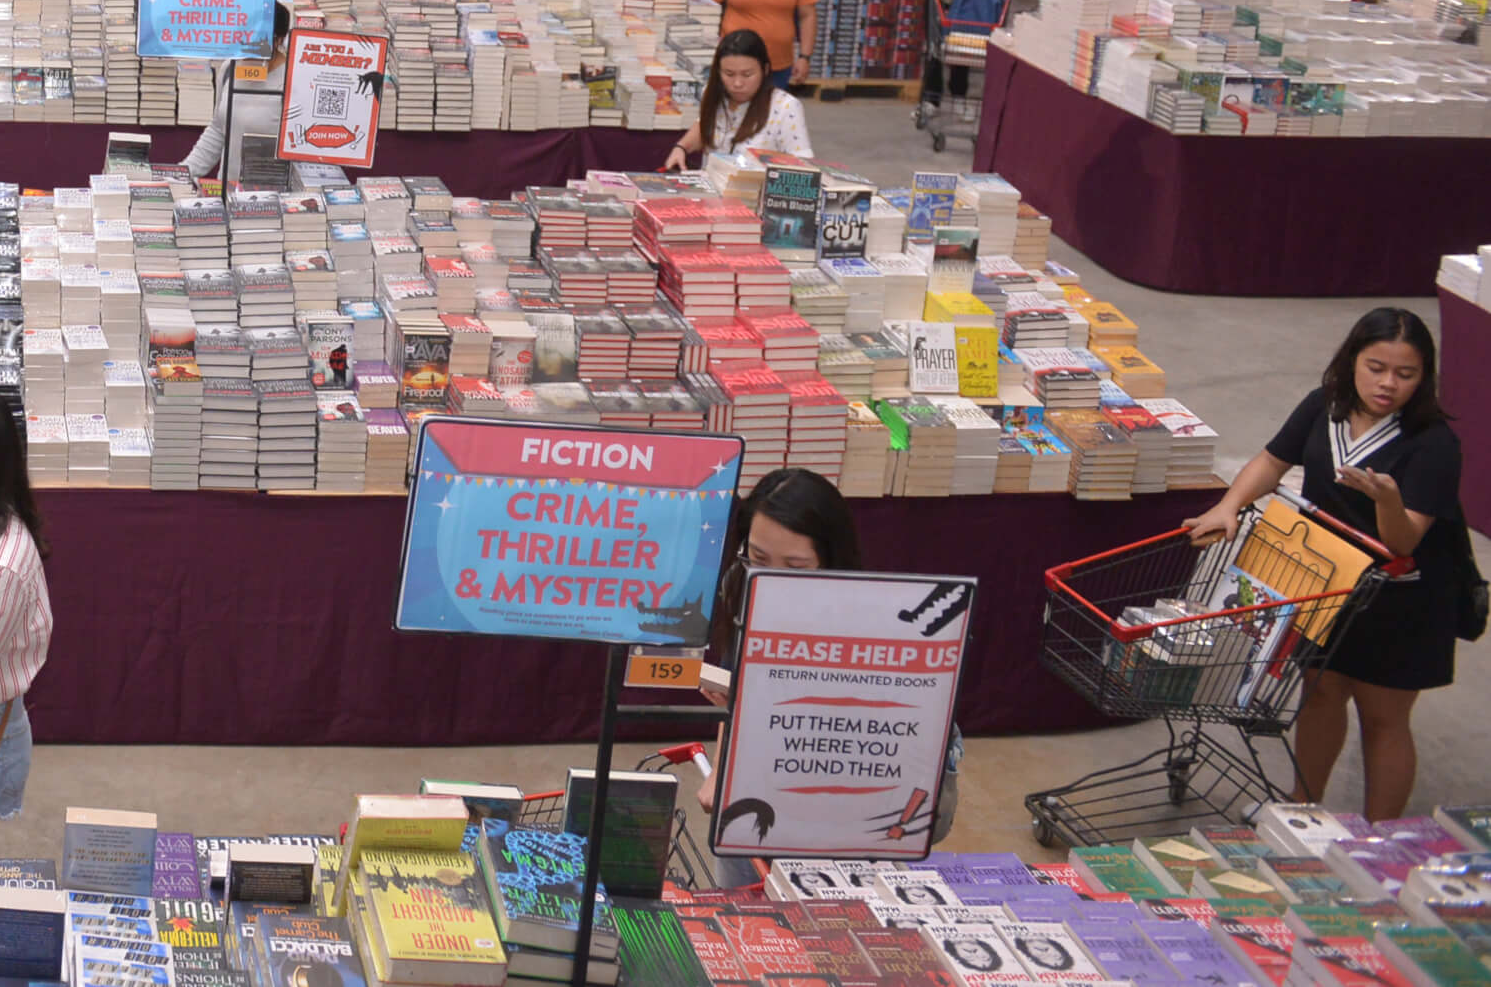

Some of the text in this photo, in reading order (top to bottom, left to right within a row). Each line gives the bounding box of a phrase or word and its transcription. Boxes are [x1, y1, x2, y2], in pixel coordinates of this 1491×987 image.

[169, 11, 248, 26] THRILLER
[161, 29, 254, 45] & MYSTERY
[304, 43, 322, 51] ARE
[324, 44, 345, 54] YOU
[299, 52, 373, 69] MEMBER?
[244, 69, 259, 77] 160
[777, 172, 814, 184] STUART
[767, 184, 819, 198] MACBRIDE
[766, 199, 815, 211] Dark Blood
[823, 225, 869, 242] CUT
[310, 335, 352, 343] PARSONS
[914, 348, 956, 370] PRAYER
[404, 387, 444, 399] Fireproof
[521, 437, 655, 472] FICTION
[507, 491, 649, 537] CRIME,
[477, 529, 661, 571] THRILLER
[455, 568, 673, 610] & MYSTERY
[746, 637, 959, 668] PLEASE HELP US
[649, 662, 684, 680] 159
[769, 668, 937, 689] RETURN UNWANTED BOOKS
[769, 715, 920, 737] PUT THEM BACK
[784, 737, 899, 758] WHERE YOU
[773, 757, 902, 779] FOUND THEM
[365, 851, 469, 870] KEIGO HIGASHINO
[25, 871, 43, 880] THE
[408, 888, 445, 904] SUN
[154, 901, 212, 923] GUIL
[390, 902, 475, 923] MIDNIGHT
[291, 920, 321, 929] Club
[428, 922, 445, 932] THE
[931, 925, 957, 933] MAN
[159, 931, 219, 948] KELLERMA
[274, 926, 341, 940] The Camel
[271, 939, 352, 956] BALDACCI
[411, 932, 471, 951] UNDER
[739, 944, 787, 955] painted
[761, 937, 798, 948] house
[963, 972, 1031, 983] GRISHAM
[1036, 972, 1102, 981] GRISHAM
